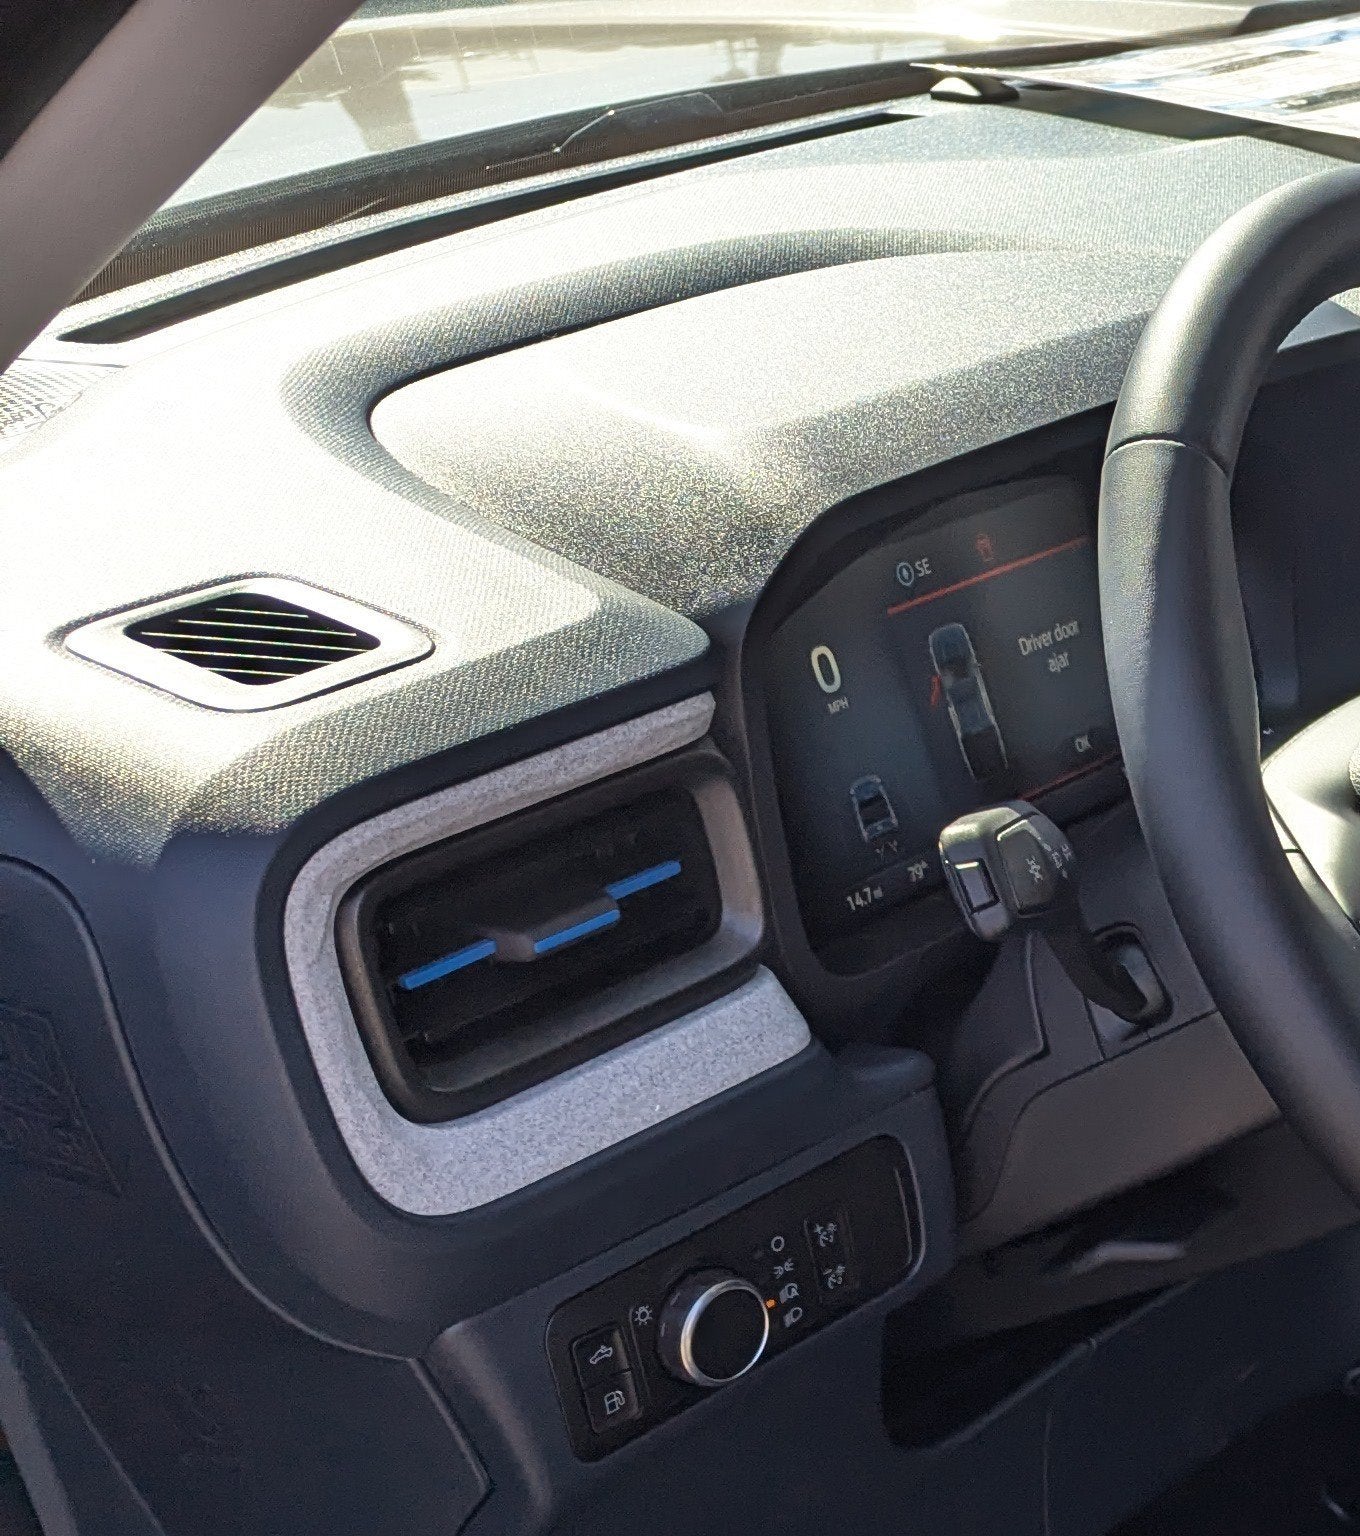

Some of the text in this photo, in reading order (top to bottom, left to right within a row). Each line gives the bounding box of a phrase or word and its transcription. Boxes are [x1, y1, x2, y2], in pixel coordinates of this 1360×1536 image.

[914, 557, 931, 577] SE
[1018, 621, 1079, 656] Driver door
[811, 645, 841, 693] 0
[1048, 651, 1069, 673] ajar
[1075, 734, 1093, 753] OK
